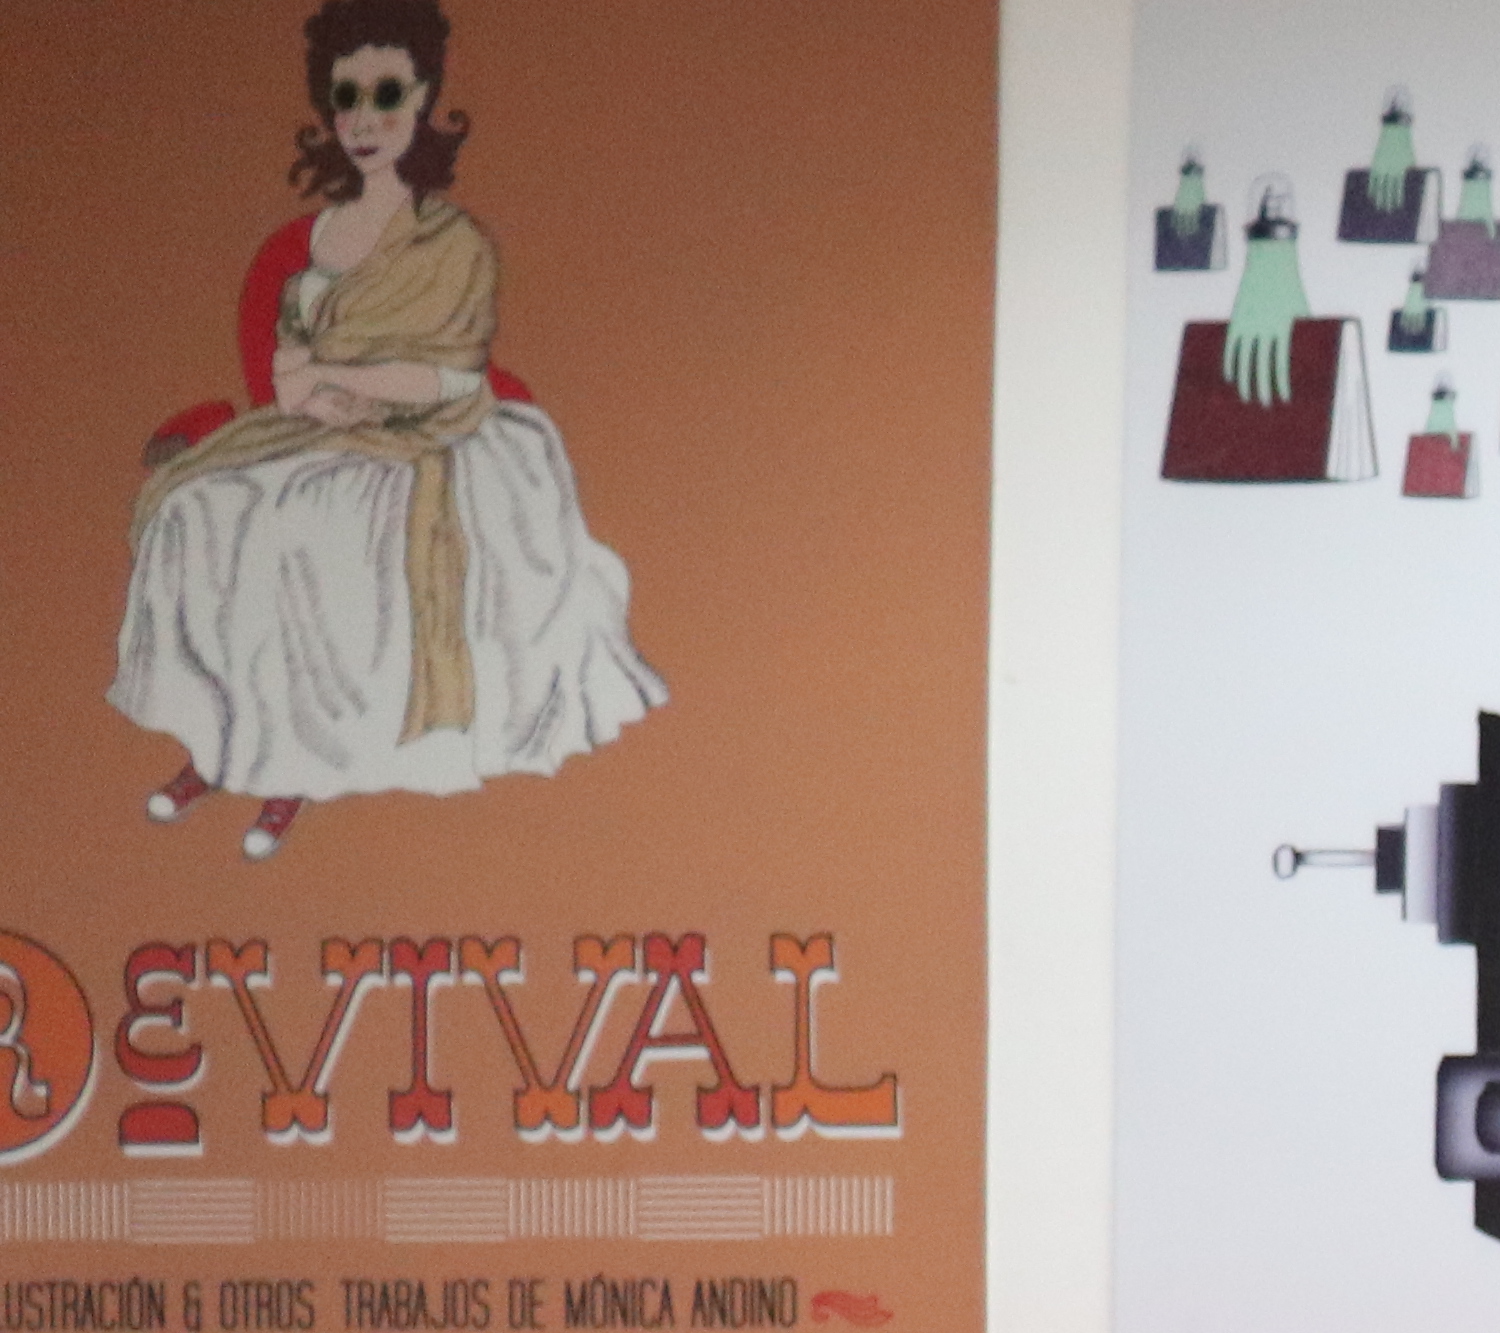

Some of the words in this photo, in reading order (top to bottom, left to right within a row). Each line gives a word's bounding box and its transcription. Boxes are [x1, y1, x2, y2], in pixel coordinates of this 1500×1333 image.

[0, 1276, 166, 1332] USTRACIÓN
[219, 1279, 316, 1331] OTROS
[341, 1279, 491, 1331] TRABAJOS
[507, 1279, 547, 1330] DE
[563, 1272, 676, 1330] MÓNICA
[690, 1277, 798, 1329] ANDINO
